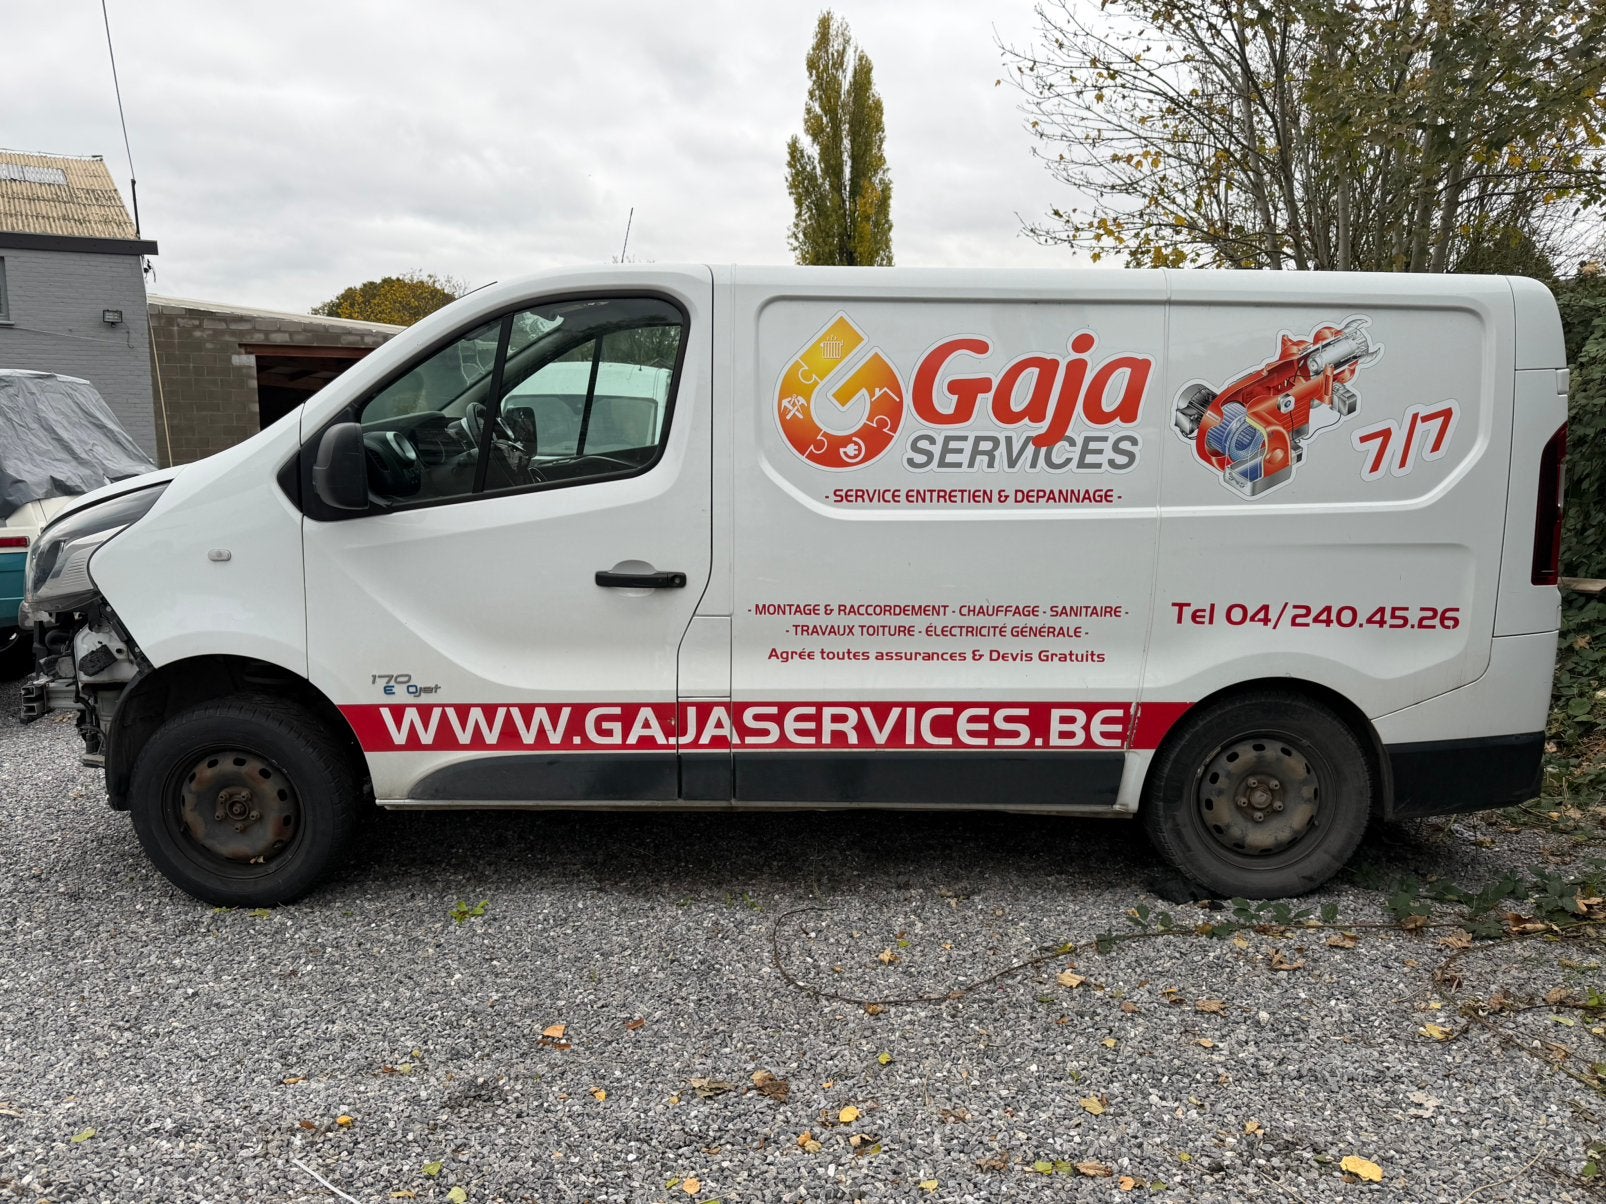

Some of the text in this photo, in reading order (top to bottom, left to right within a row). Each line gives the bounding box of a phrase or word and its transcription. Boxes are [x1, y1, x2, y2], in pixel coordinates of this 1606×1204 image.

[911, 333, 1152, 449] Gaja
[1358, 406, 1455, 475] 7/7
[906, 434, 1139, 471] SERVICES
[833, 488, 901, 505] SERVICE
[905, 488, 994, 505] ENTRETIEN
[997, 488, 1011, 505] &
[1014, 488, 1115, 505] DEPANNAGE
[755, 603, 820, 617] MONTAGE
[824, 604, 835, 617] &
[838, 604, 949, 618] RACCORDEMENT
[959, 604, 1040, 618] CHAUFFAGE
[1050, 605, 1122, 618] SANITAIRE
[1171, 602, 1461, 631] Tel 04/240.45.26
[792, 624, 855, 638] TRAVAUX
[859, 624, 916, 638] TOITURE
[925, 623, 1007, 639] ÉLECTRICITÉ
[1010, 624, 1083, 640] GÉNÉRALE
[768, 647, 1106, 665] Agrée toutes assurances & Devis Gratuits
[371, 674, 412, 685] 170
[378, 705, 1124, 748] WWW.GAJASERVICES.BE
